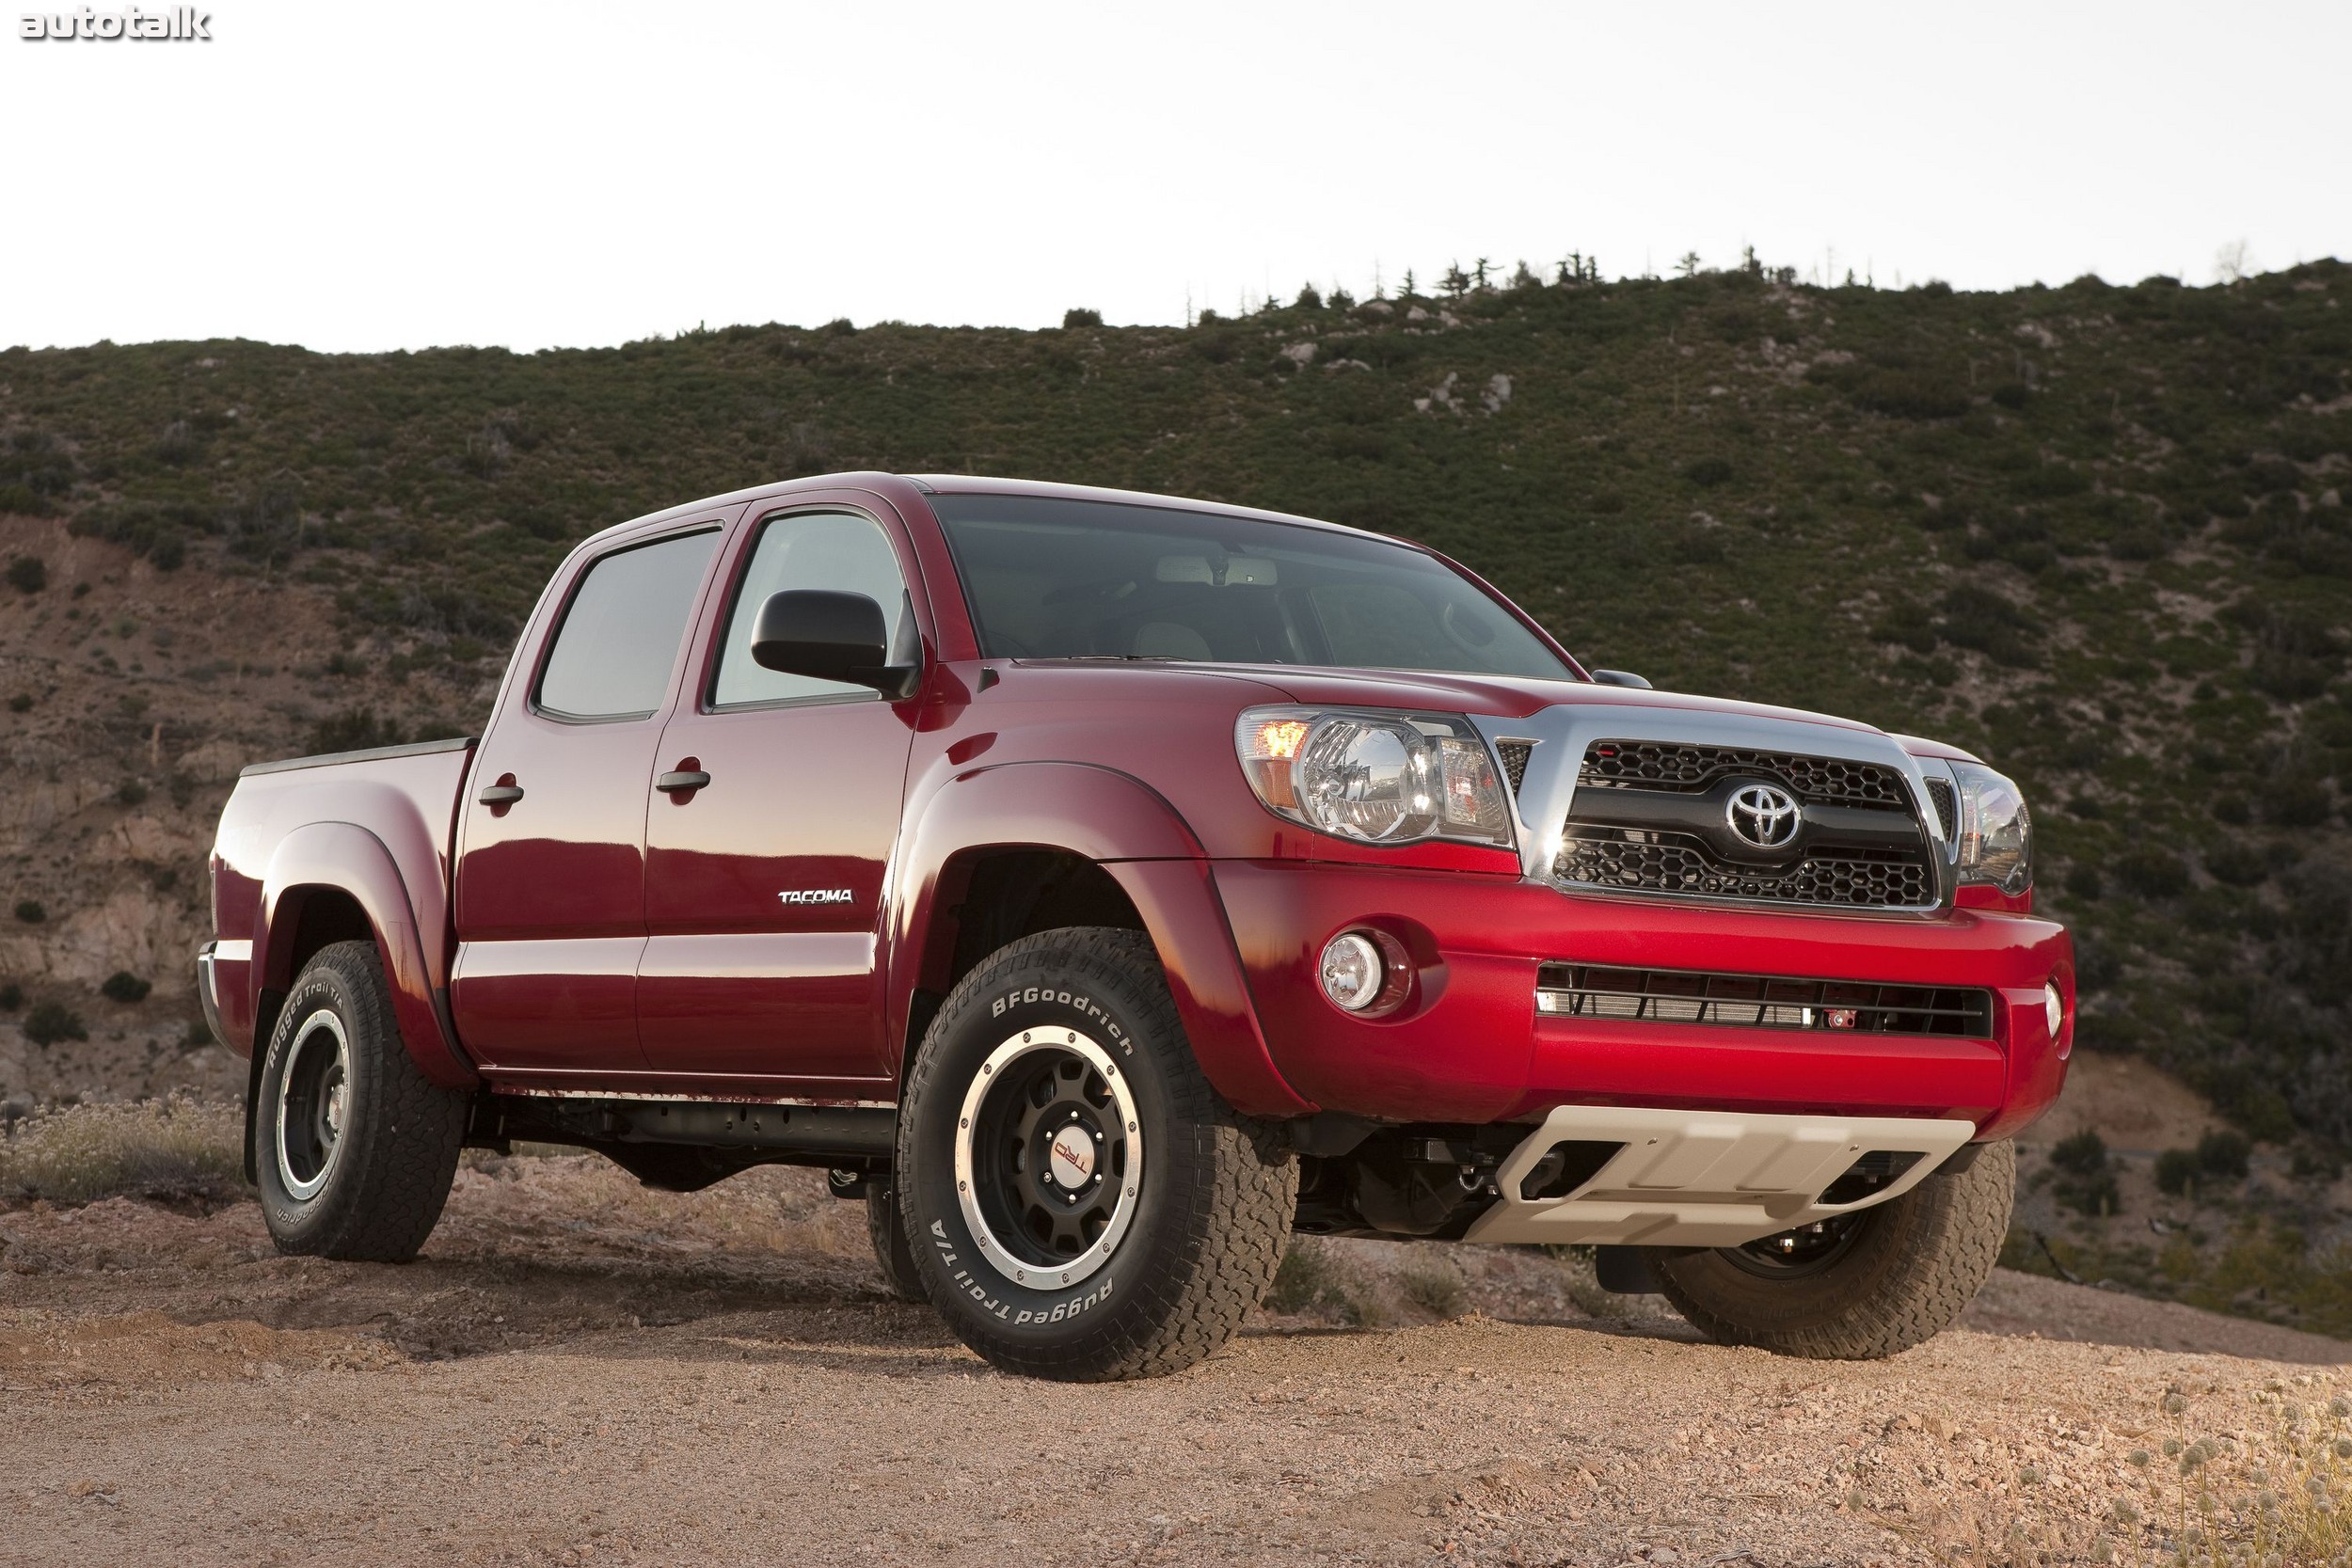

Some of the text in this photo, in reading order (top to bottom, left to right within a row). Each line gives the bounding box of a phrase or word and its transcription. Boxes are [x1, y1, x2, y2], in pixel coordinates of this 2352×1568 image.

[778, 890, 853, 904] TACOMA
[269, 990, 303, 1069] Rugged
[305, 982, 329, 997] Trail
[993, 988, 1134, 1056] BFGoodrich
[1055, 1142, 1087, 1174] TRD
[930, 1219, 1114, 1325] Rugged Trail T/A
